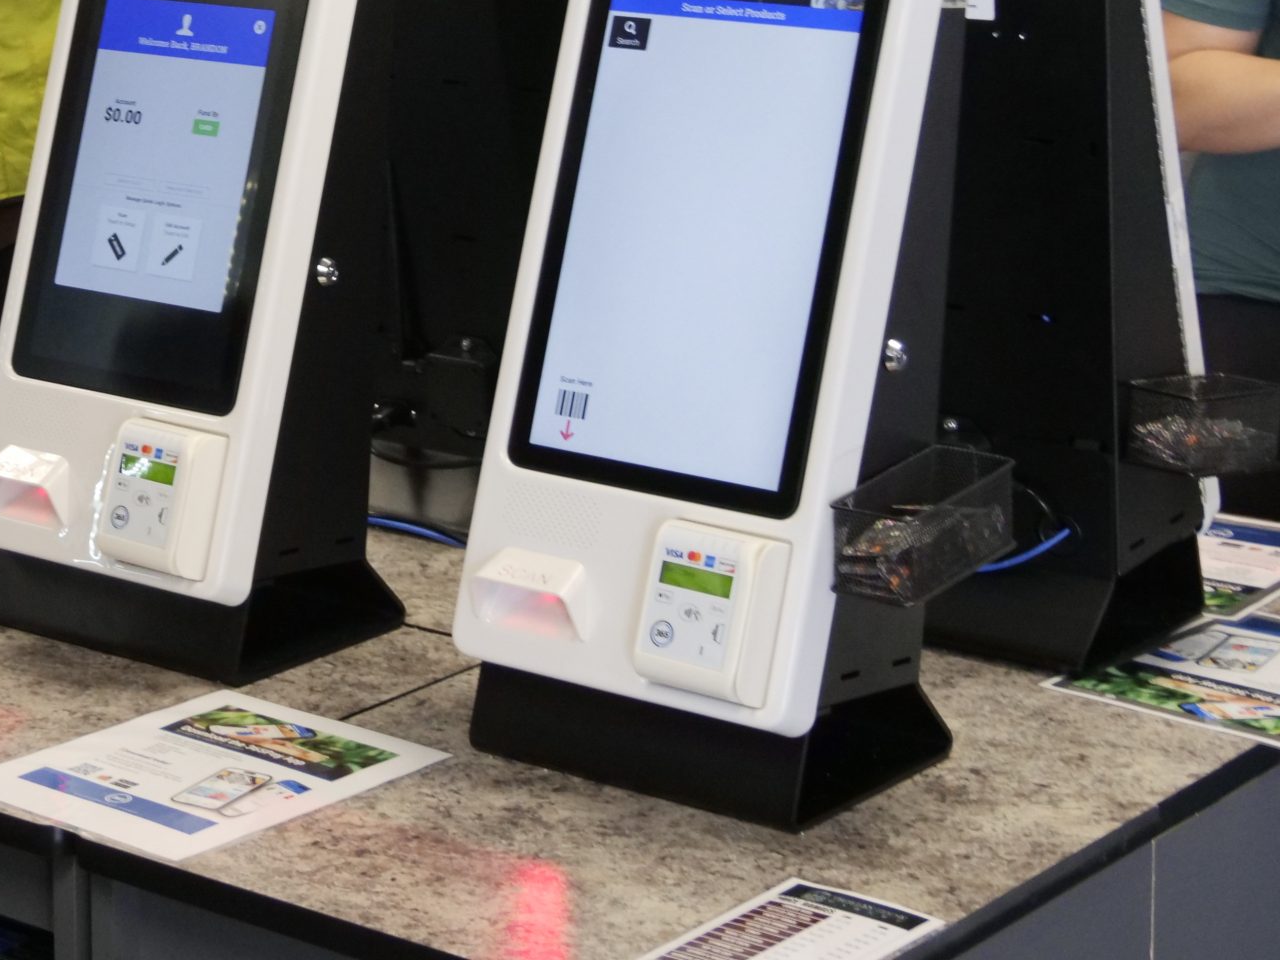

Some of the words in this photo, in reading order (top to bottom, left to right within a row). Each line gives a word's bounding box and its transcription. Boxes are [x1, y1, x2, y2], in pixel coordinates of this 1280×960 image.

[681, 2, 703, 13] Scan
[704, 6, 715, 15] or
[715, 6, 744, 17] Select
[744, 8, 786, 20] Products
[138, 37, 169, 48] Welcome
[616, 36, 640, 47] Search
[104, 107, 142, 125] $0.00
[665, 547, 684, 559] VISA
